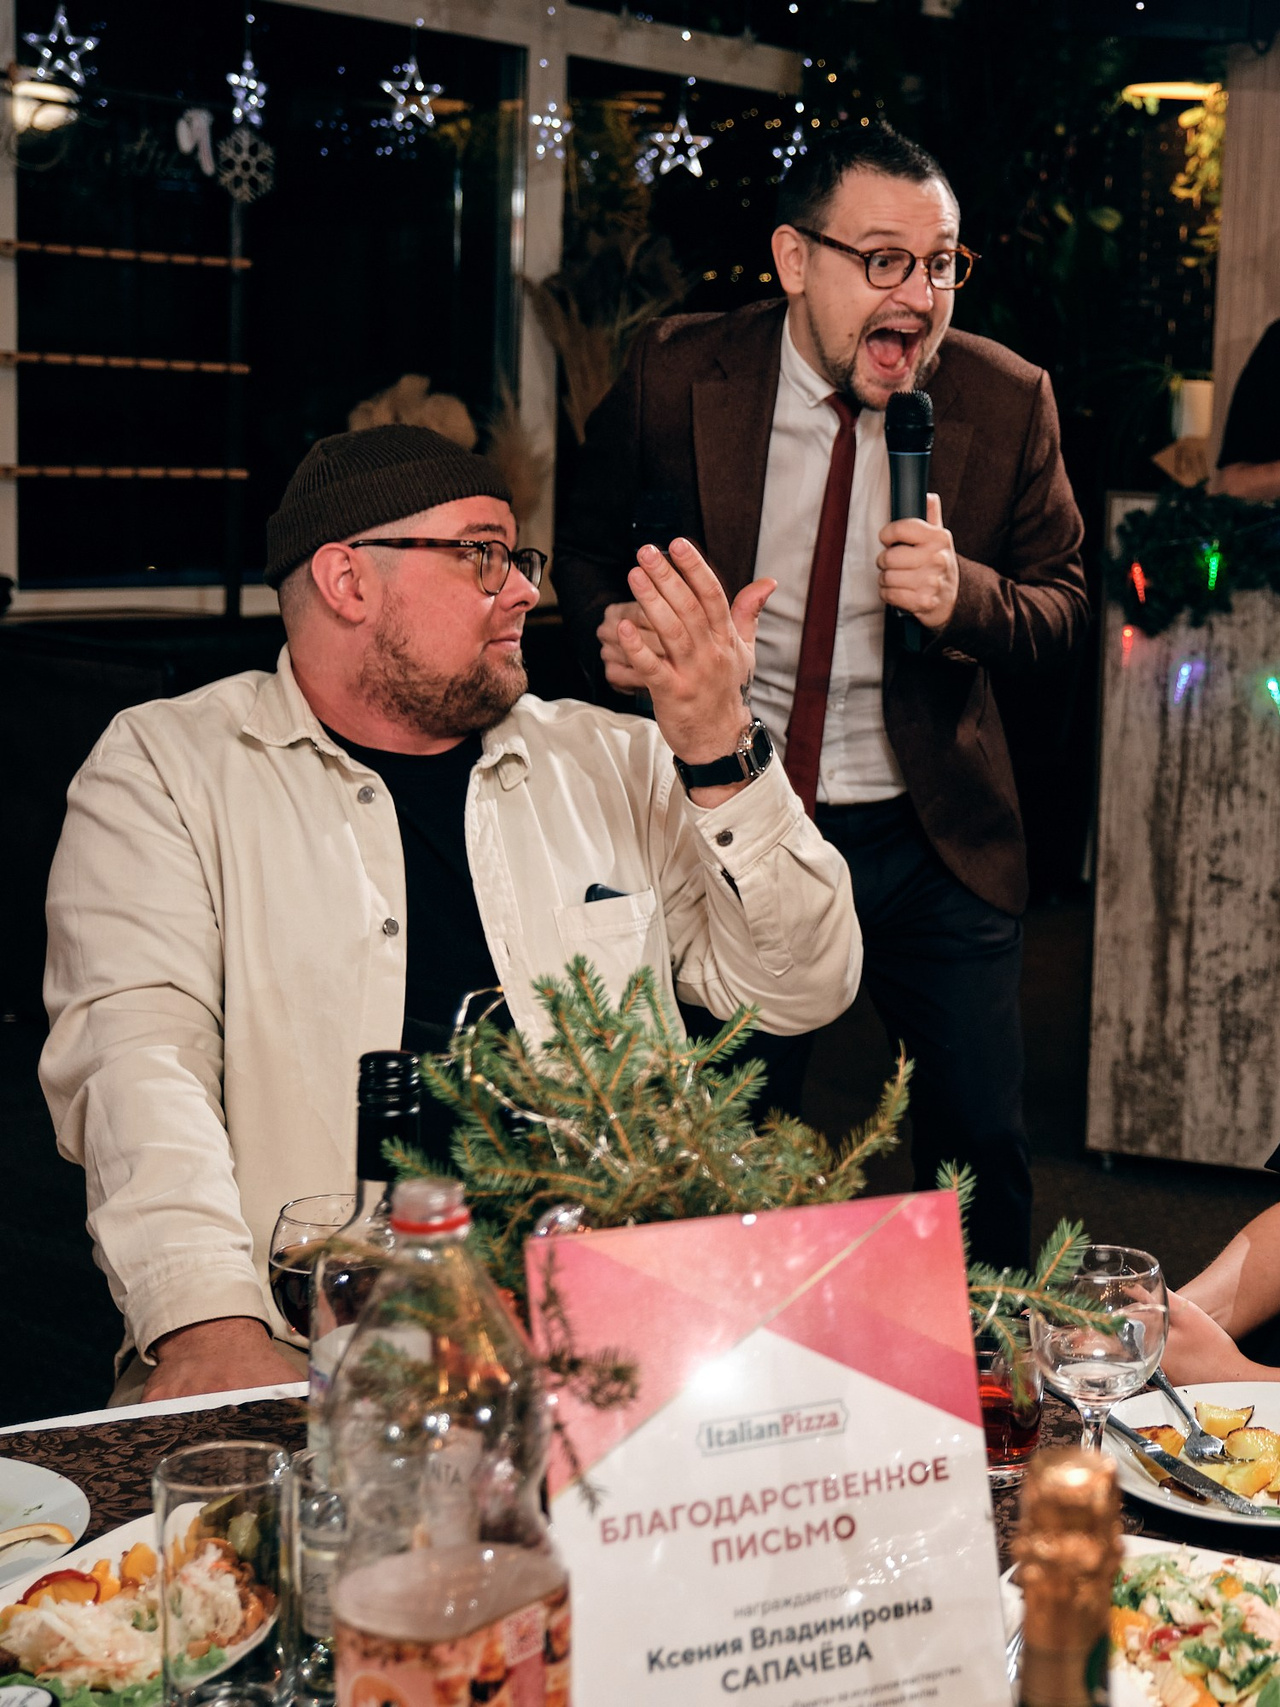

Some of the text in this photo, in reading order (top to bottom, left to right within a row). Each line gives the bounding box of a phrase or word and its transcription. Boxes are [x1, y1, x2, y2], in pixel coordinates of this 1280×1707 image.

[706, 1411, 840, 1449] ItalianPizza
[601, 1456, 950, 1545] БЛАГОДАРСТВЕННОЕ
[711, 1513, 857, 1566] ПИСЬМО
[647, 1596, 933, 1674] Ксения Владимировна
[721, 1640, 873, 1694] САПАЧЁВА
